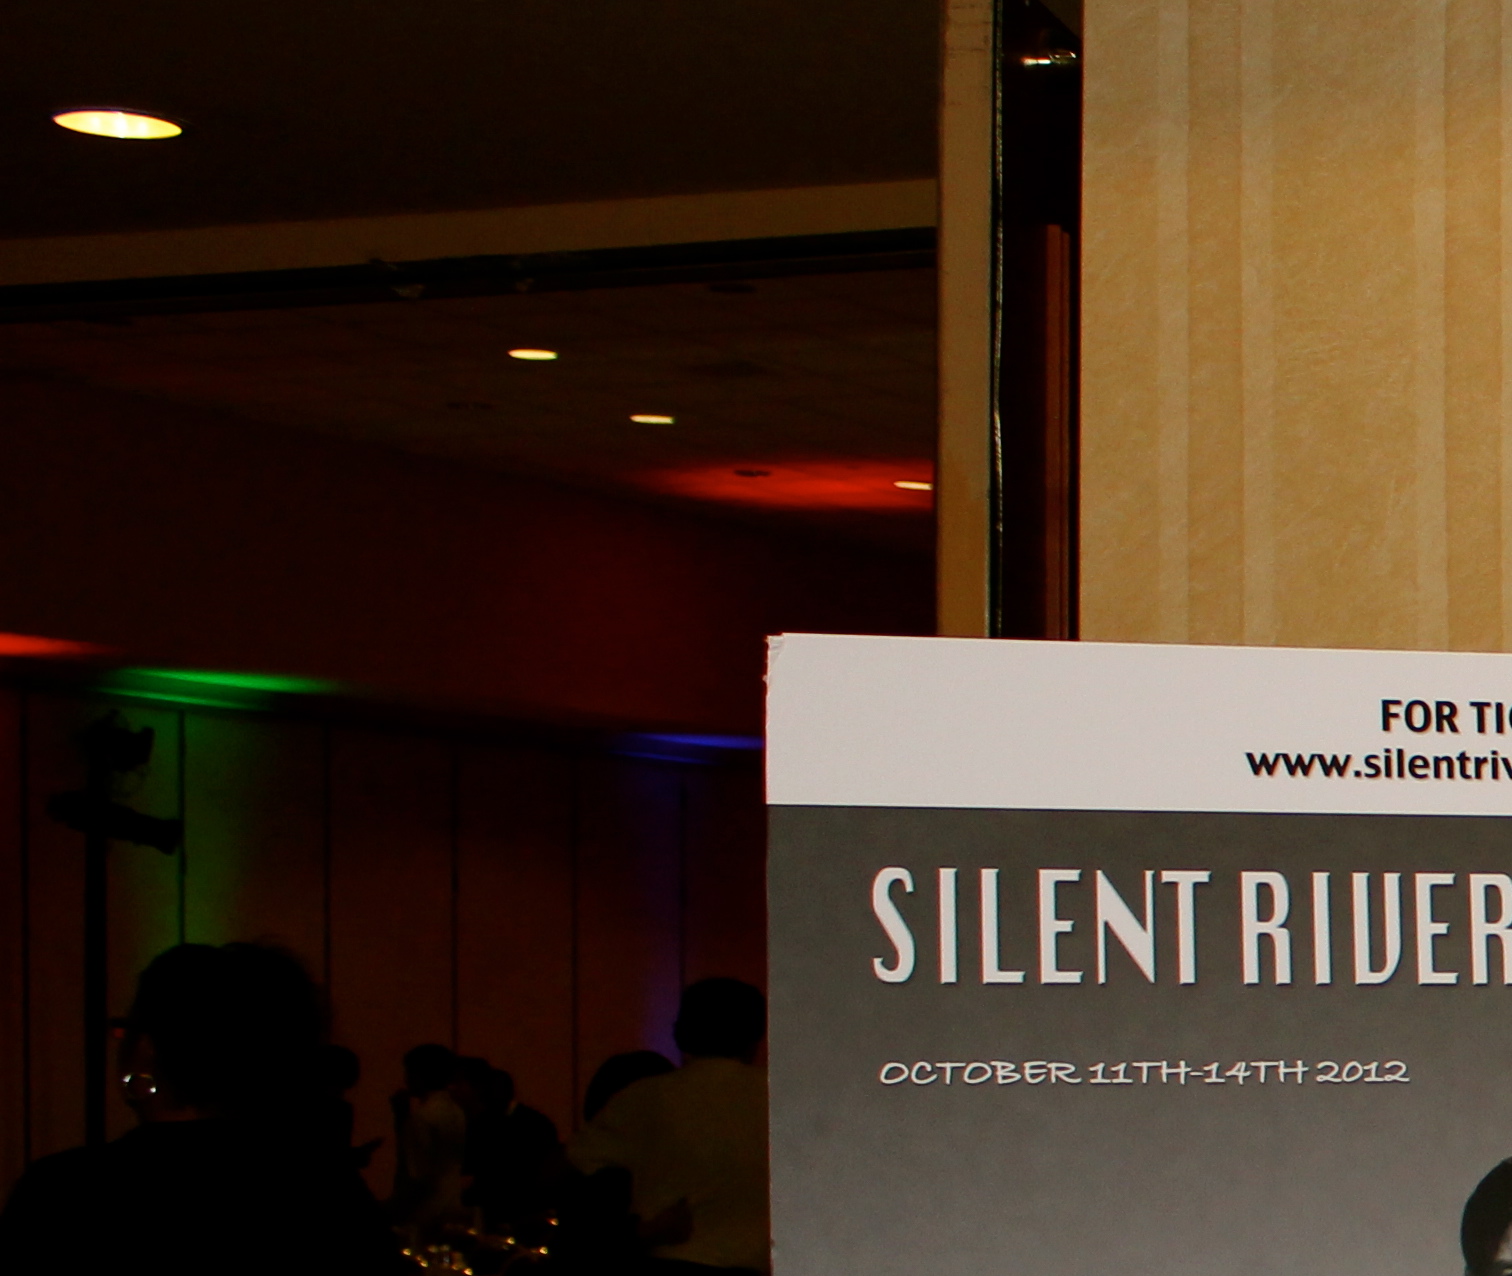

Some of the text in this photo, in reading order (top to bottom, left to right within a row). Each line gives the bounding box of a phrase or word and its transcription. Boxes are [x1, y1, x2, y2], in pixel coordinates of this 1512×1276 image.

[1381, 699, 1459, 734] FOR
[872, 867, 1211, 985] SILENT
[879, 1059, 1410, 1085] OCTOBER 11TH-14TH 2012
